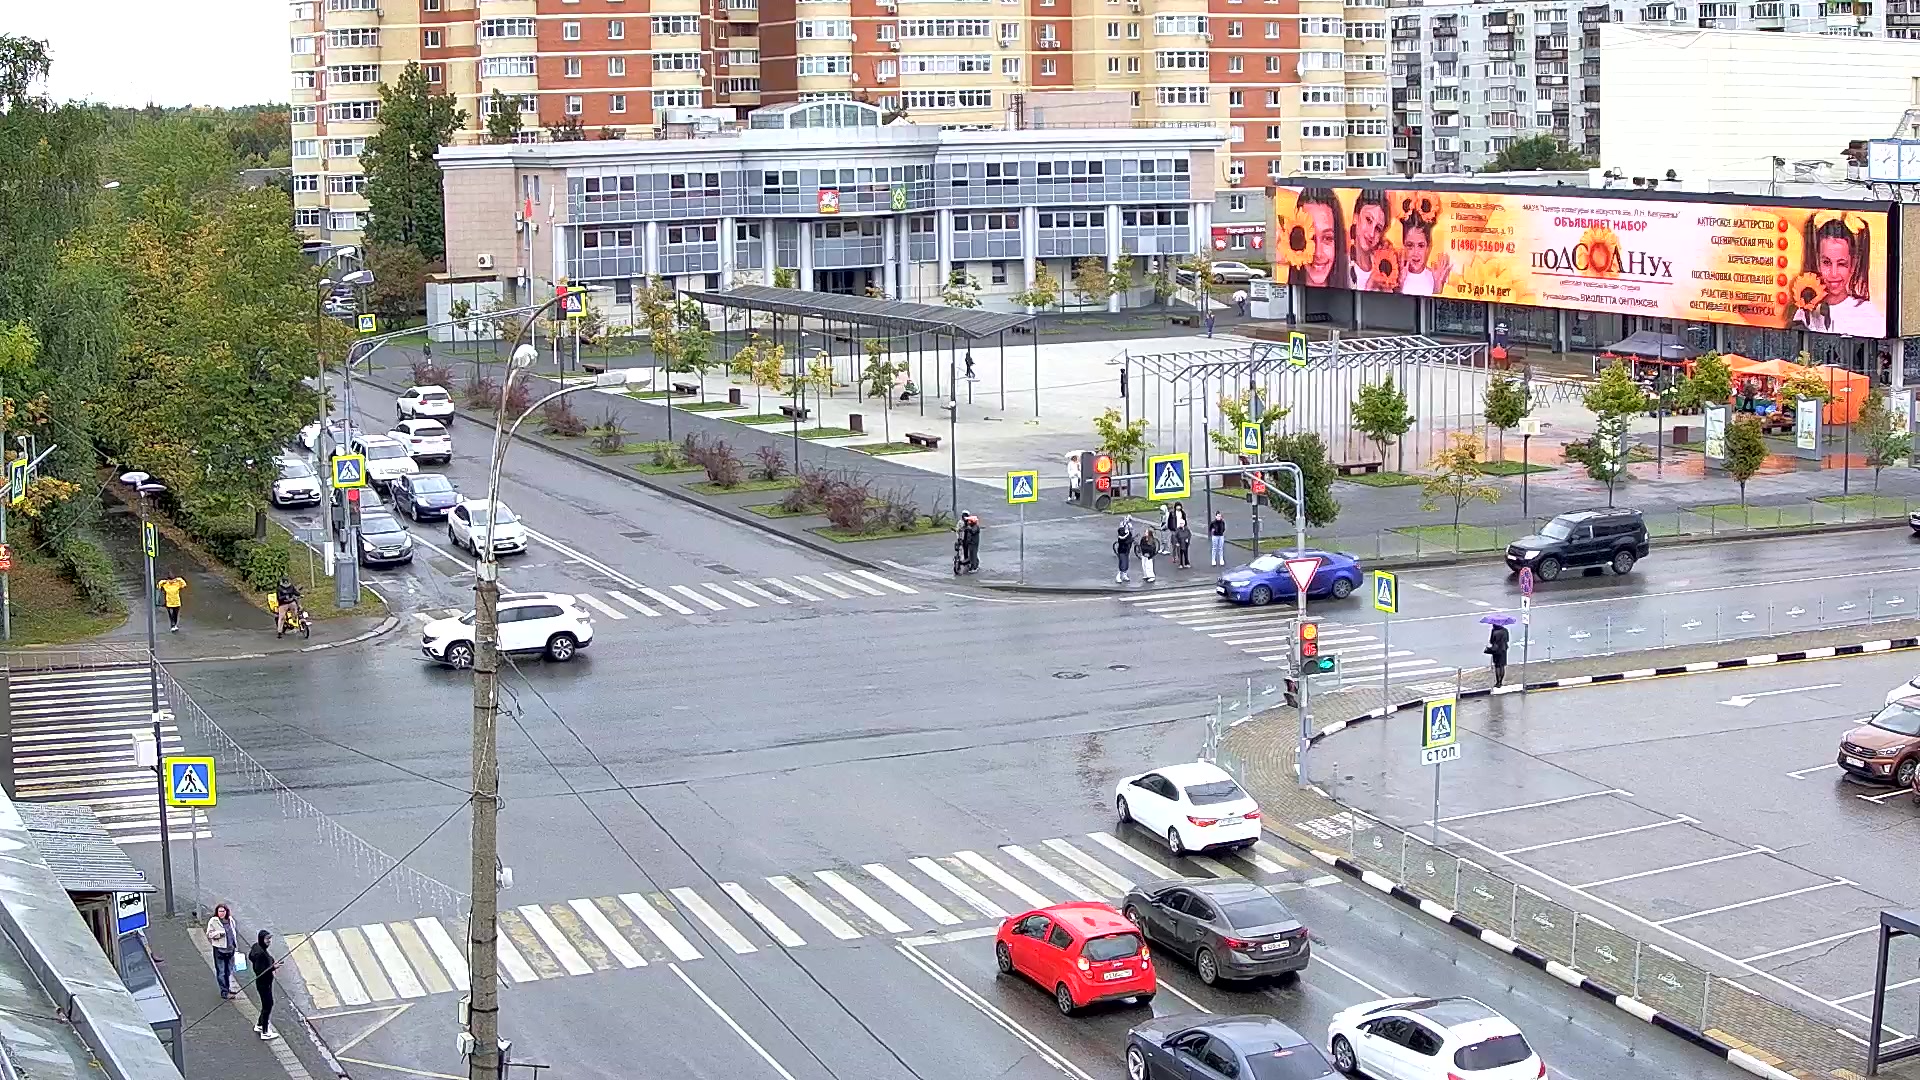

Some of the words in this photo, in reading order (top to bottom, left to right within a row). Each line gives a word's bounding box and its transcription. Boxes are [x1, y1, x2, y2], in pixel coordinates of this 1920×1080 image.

[1554, 217, 1610, 229] ОБЪЯВЛЯЕТ
[1613, 219, 1648, 232] НАБОР
[1457, 239, 1477, 252] (496)
[1478, 240, 1493, 252] 536
[1494, 241, 1504, 253] 09
[1757, 238, 1774, 249] РЕЧЬ
[1531, 243, 1673, 278] ПОДСОЛНУХ
[1457, 284, 1466, 293] от
[1467, 283, 1473, 293] 3
[1473, 285, 1484, 296] до
[1486, 285, 1495, 296] 14
[1496, 287, 1511, 297] лет
[1426, 746, 1456, 761] СТОП
